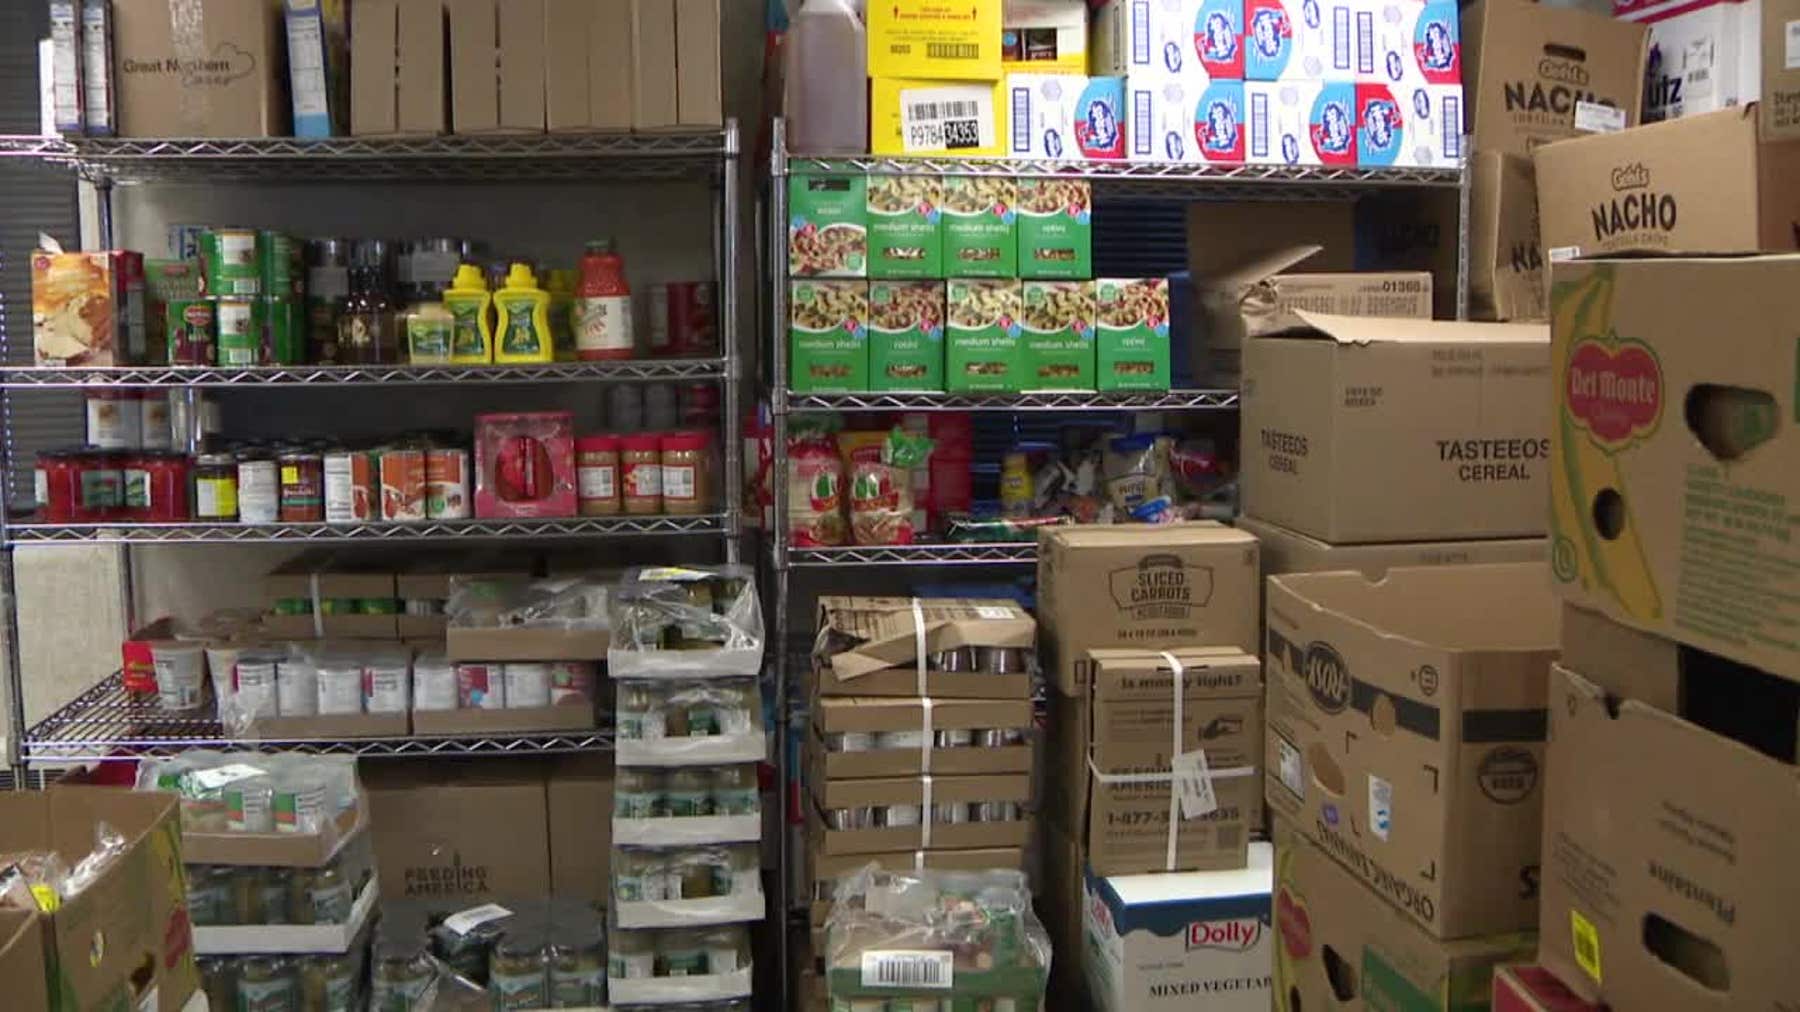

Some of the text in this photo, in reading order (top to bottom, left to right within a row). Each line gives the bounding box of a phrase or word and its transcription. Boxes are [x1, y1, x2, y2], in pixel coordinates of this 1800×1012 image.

[122, 58, 162, 73] Great
[1592, 193, 1676, 242] NACHO
[1436, 438, 1551, 461] TASTEEOS
[1458, 463, 1531, 481] CEREAL
[1138, 570, 1185, 587] SLICED
[1130, 586, 1191, 603] CARROTS
[1190, 921, 1255, 947] Dolly
[1149, 982, 1199, 998] MIXED
